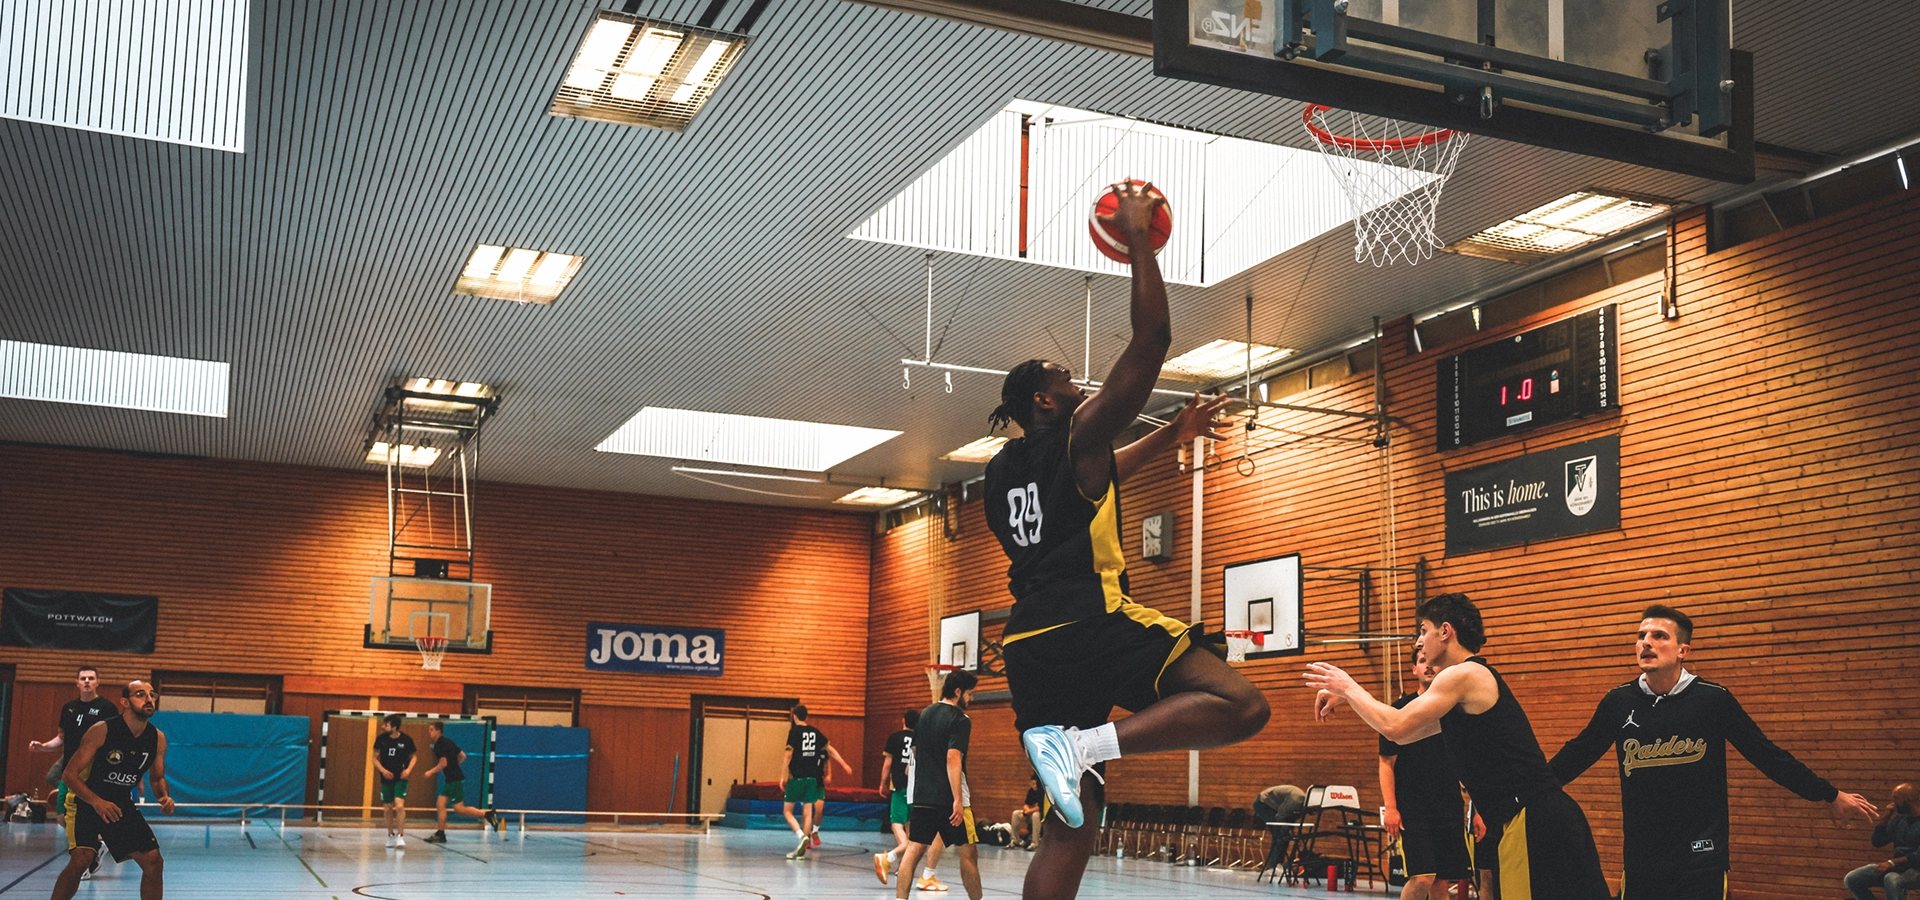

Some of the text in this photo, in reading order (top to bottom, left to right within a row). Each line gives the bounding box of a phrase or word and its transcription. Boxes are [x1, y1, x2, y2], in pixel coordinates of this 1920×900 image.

[1462, 480, 1549, 513] This is home.
[1007, 482, 1043, 547] 99
[48, 613, 113, 623] POTTWATCH
[76, 714, 83, 726] 4
[802, 732, 816, 750] 22
[388, 748, 396, 756] 13
[1623, 735, 1706, 768] Raiders
[138, 752, 149, 769] 7
[1330, 792, 1353, 800] Wilson
